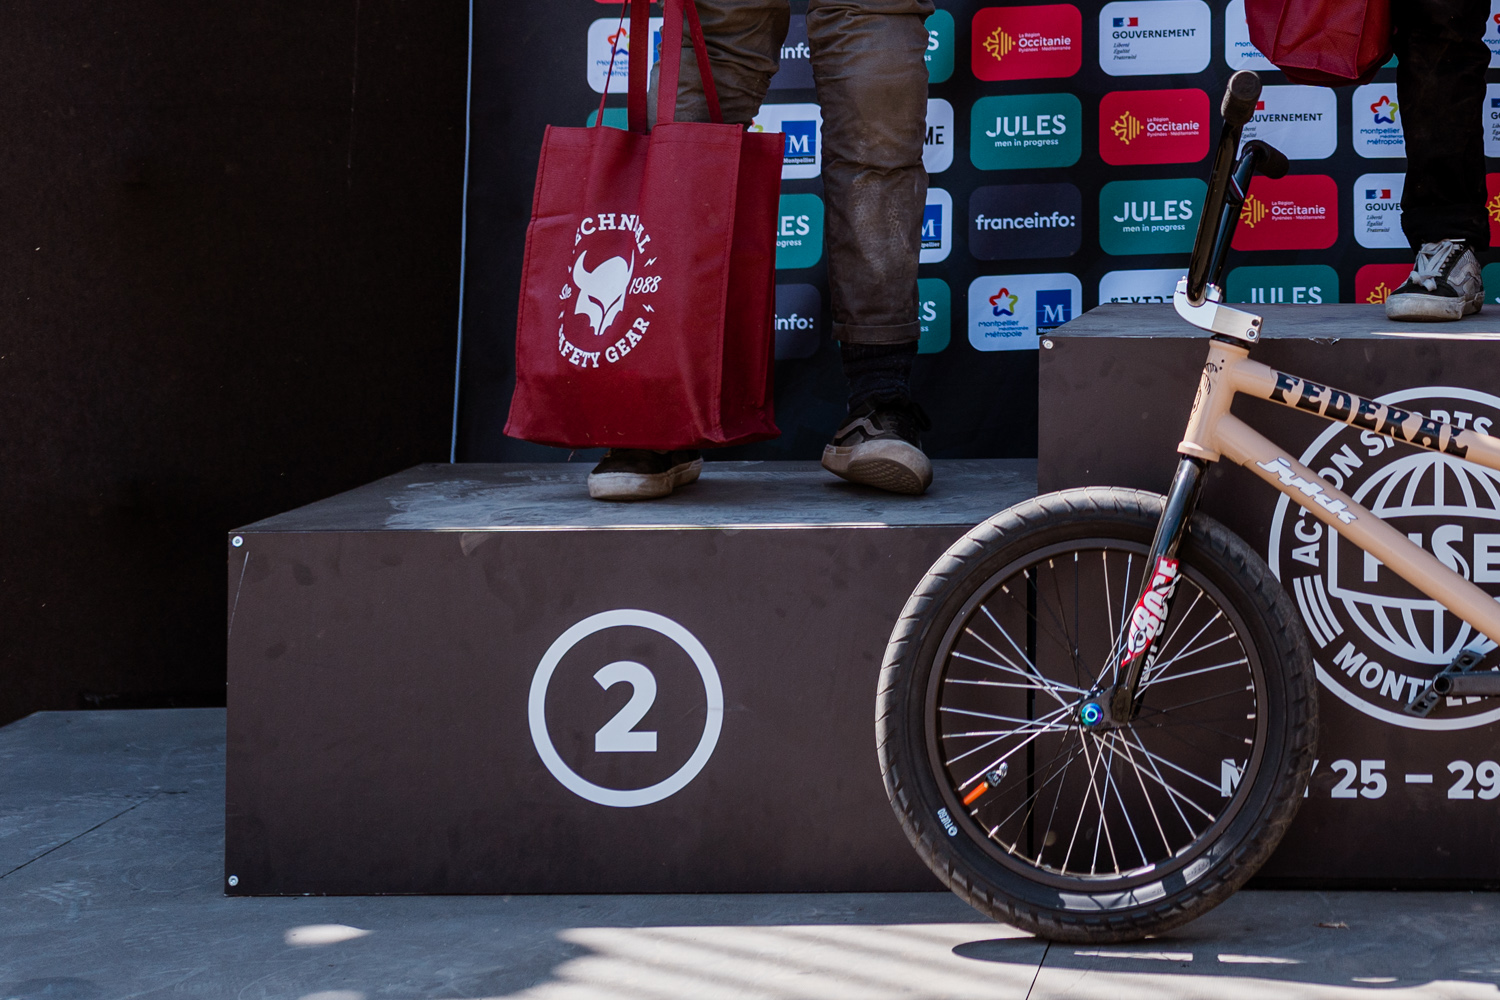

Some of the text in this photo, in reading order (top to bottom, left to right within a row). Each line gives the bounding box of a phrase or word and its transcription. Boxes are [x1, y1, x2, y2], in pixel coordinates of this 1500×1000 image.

[1019, 36, 1071, 48] Occitanie
[1112, 28, 1196, 40] GOUVERNEMENT
[986, 114, 1066, 137] JULES
[1147, 120, 1199, 132] Occitanie
[789, 134, 809, 153] M
[995, 138, 1058, 148] men in progress
[1113, 200, 1192, 222] JULES
[1272, 205, 1325, 215] Occitanie
[976, 212, 1075, 230] franceinfo:
[1142, 224, 1149, 232] in
[1152, 223, 1185, 233] progress
[605, 317, 650, 363] GEAR
[1269, 371, 1469, 459] FEDERAL
[593, 661, 657, 752] 2
[1331, 759, 1387, 799] 25
